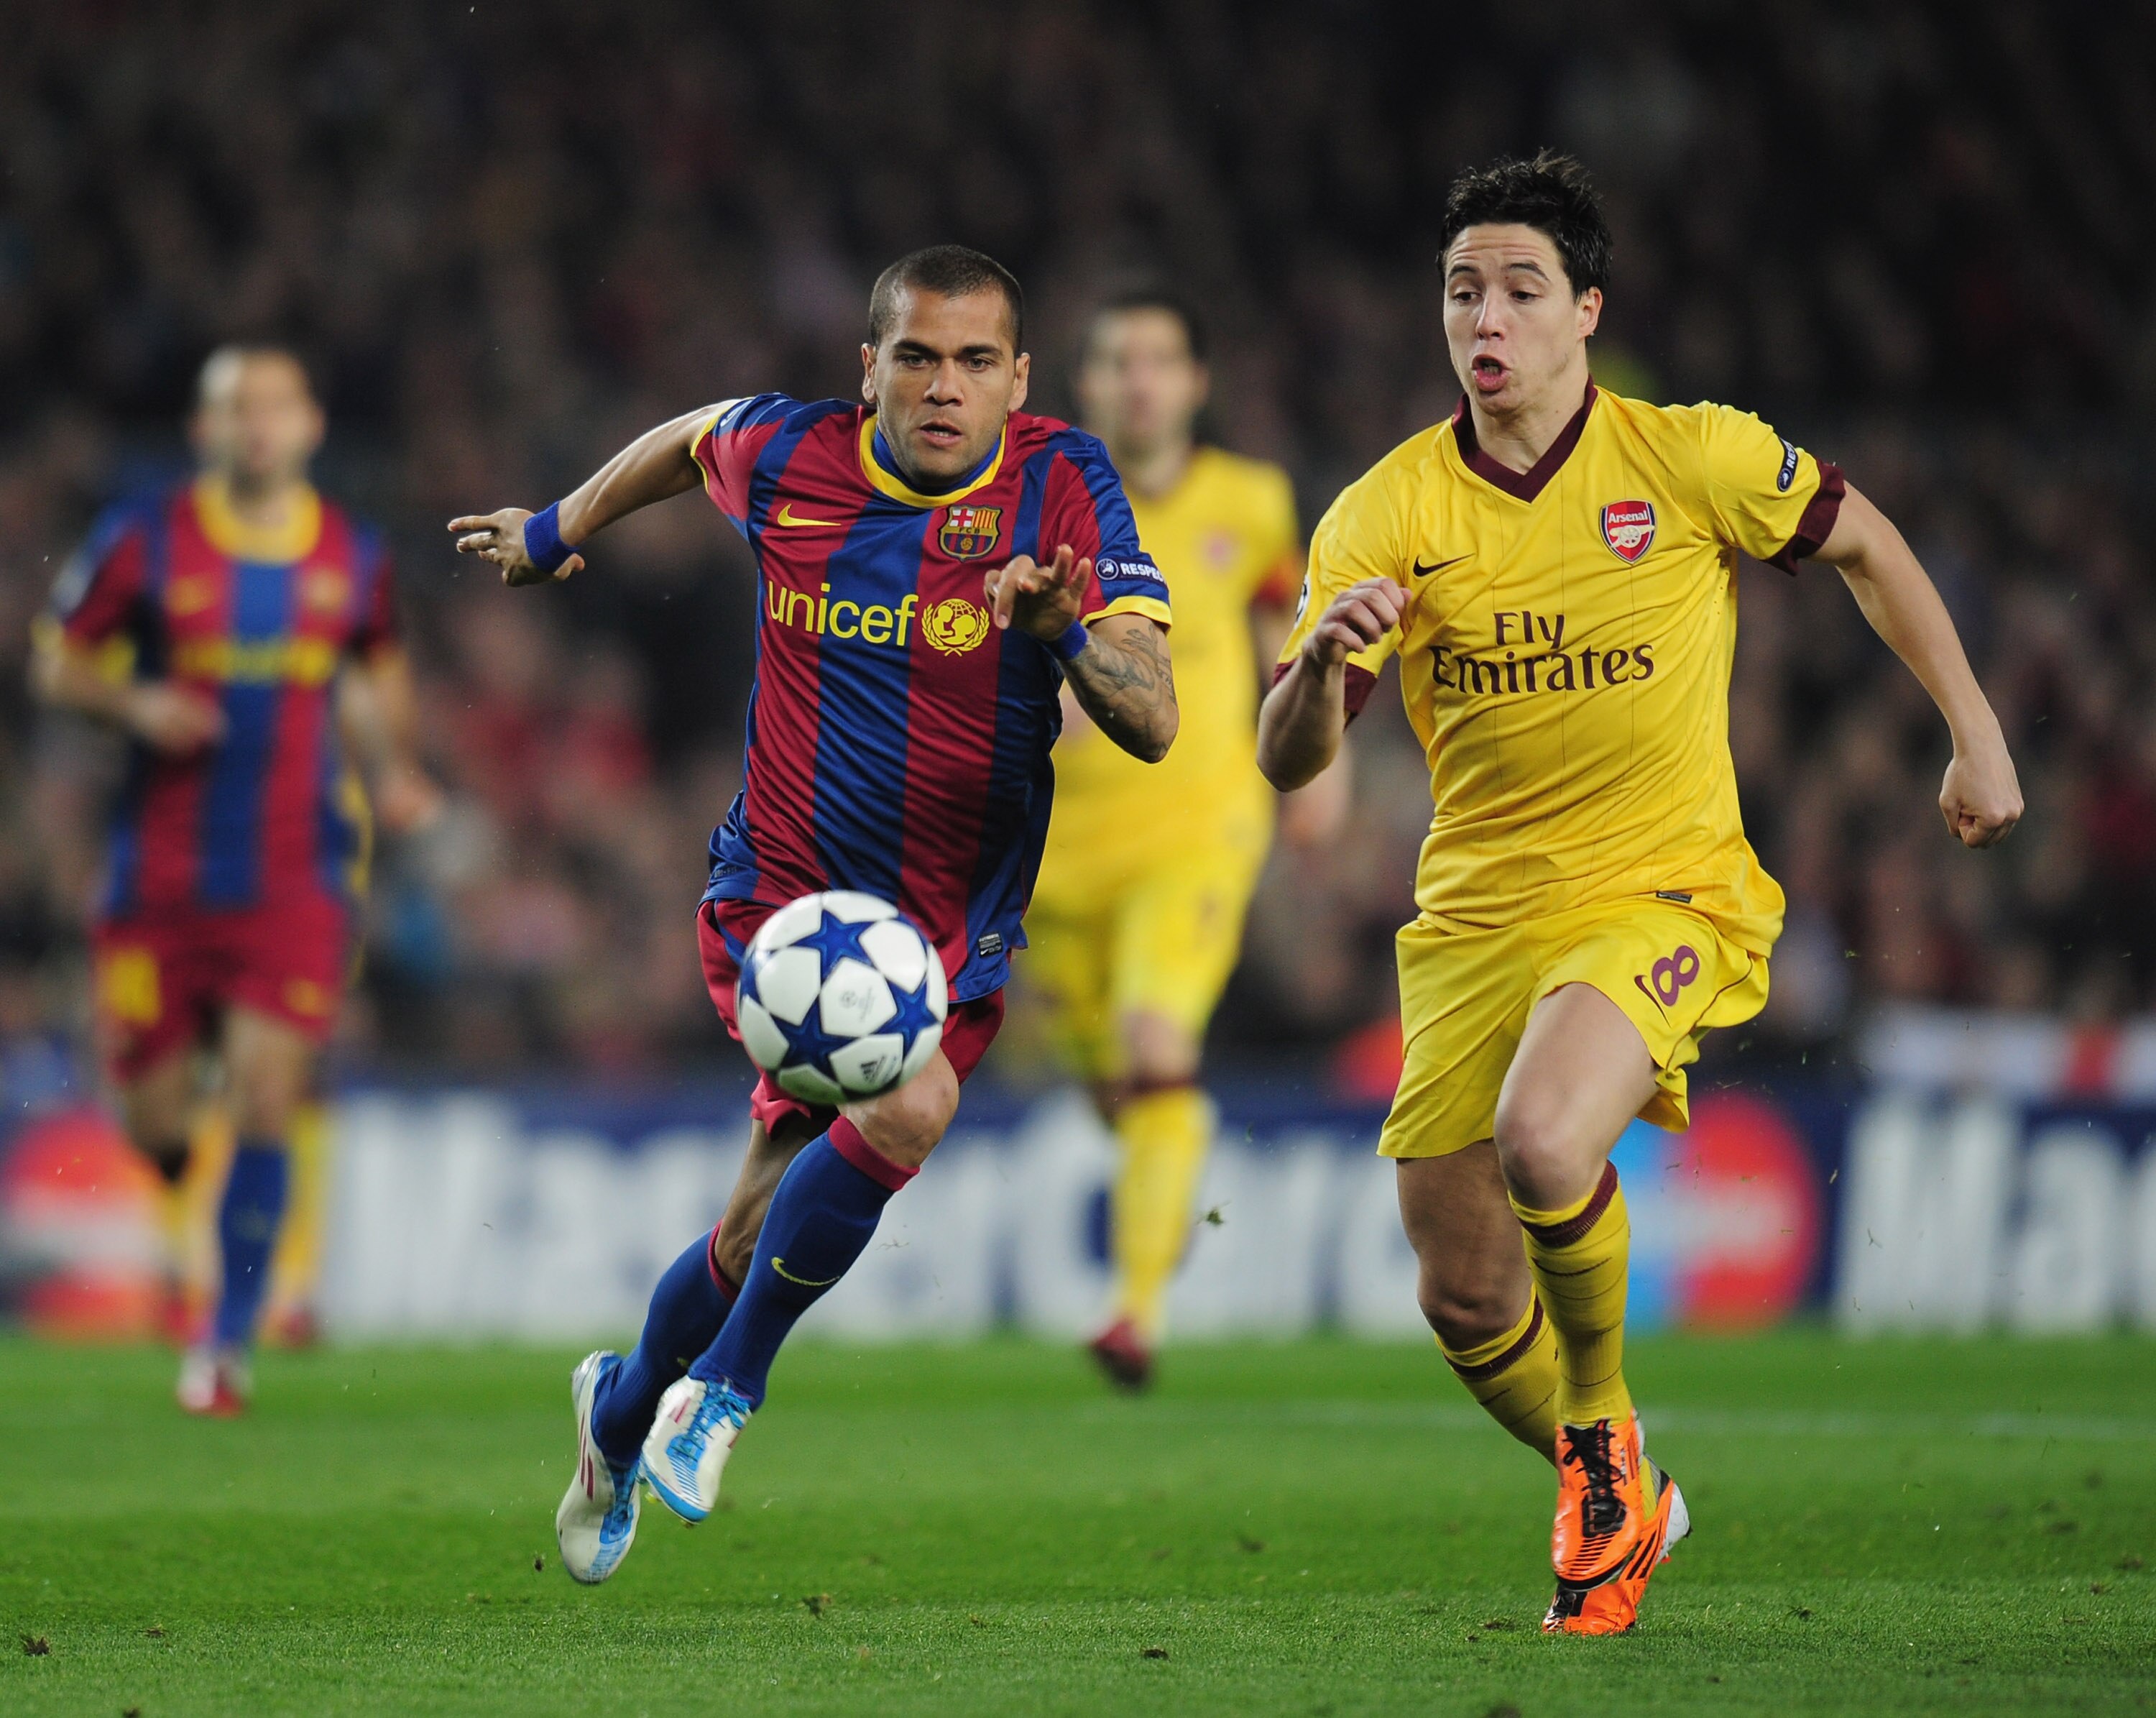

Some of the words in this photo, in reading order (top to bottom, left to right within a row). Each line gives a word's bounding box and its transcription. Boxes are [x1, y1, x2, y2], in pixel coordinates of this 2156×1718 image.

[1608, 509, 1649, 524] Arsenal
[768, 580, 919, 646] unicef
[1493, 611, 1565, 650] Fly
[1428, 644, 1655, 694] Emirates
[1651, 945, 1700, 1006] 8
